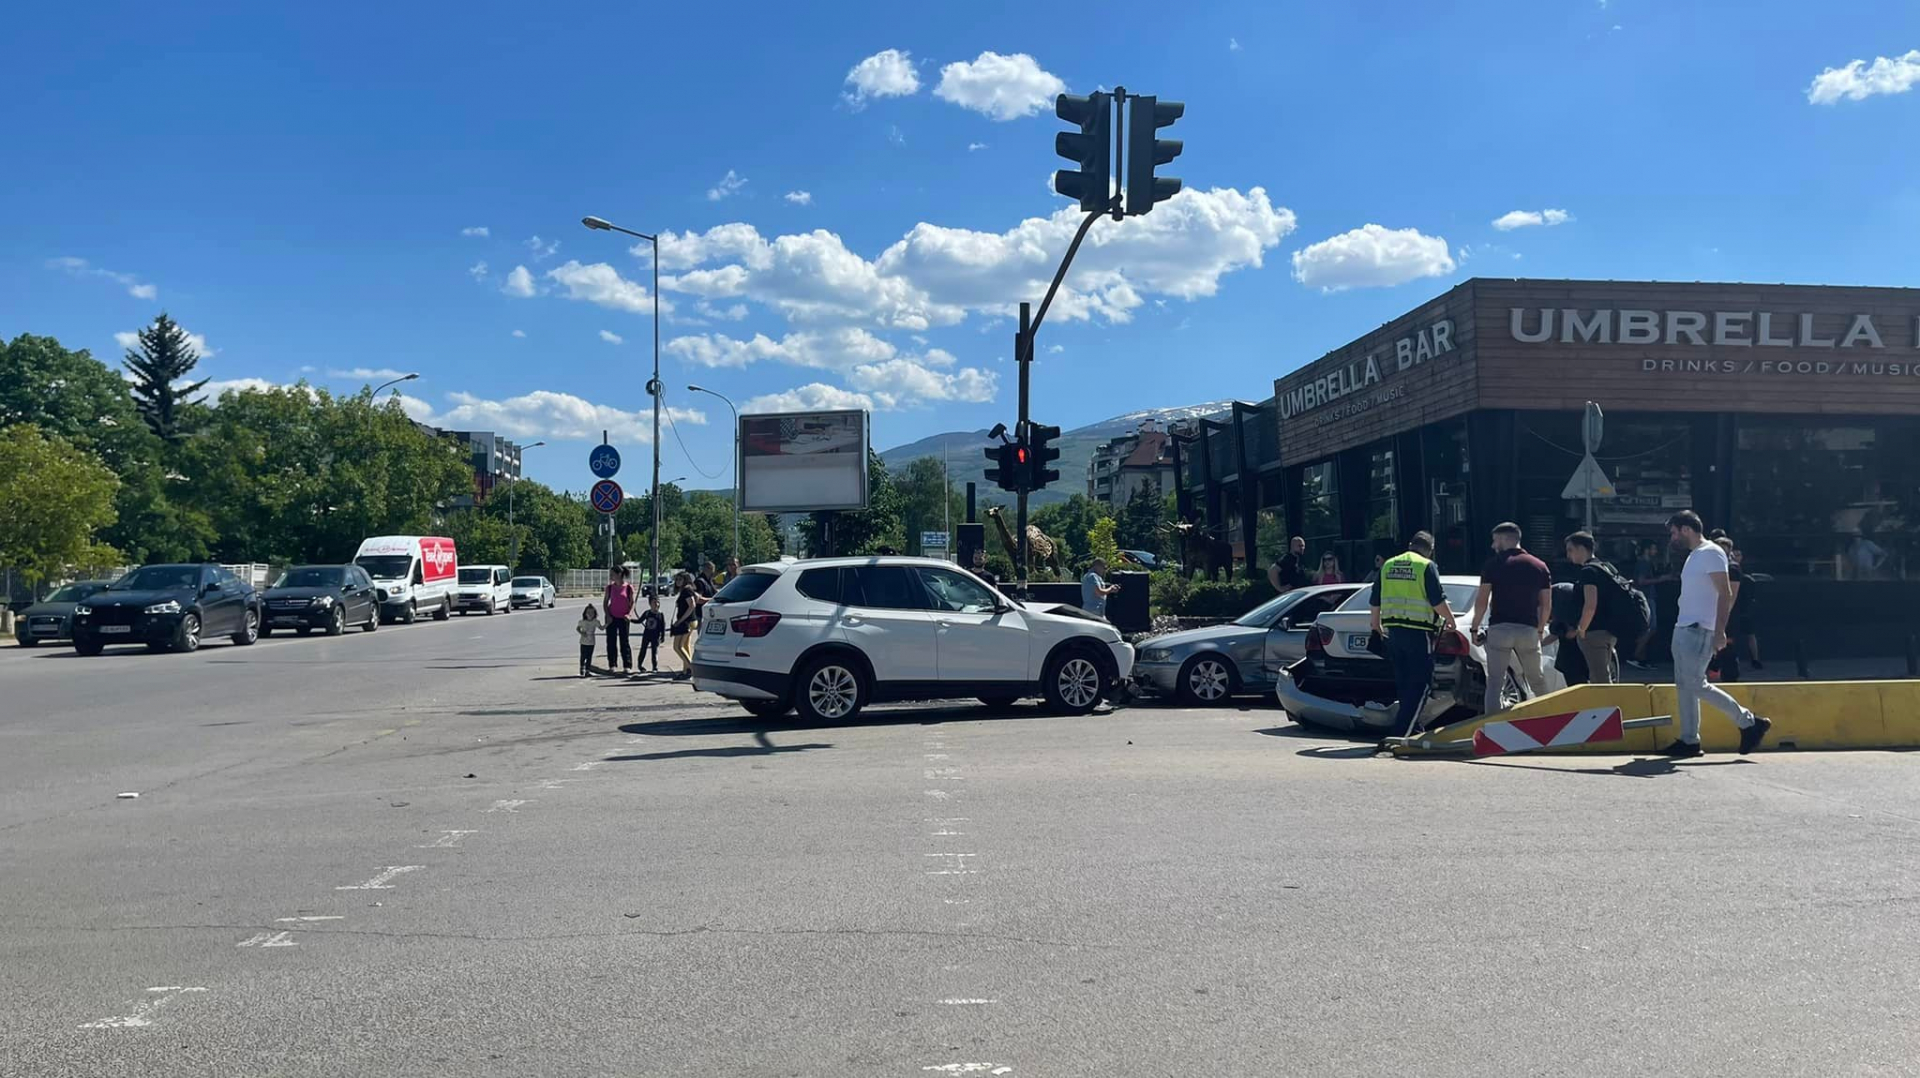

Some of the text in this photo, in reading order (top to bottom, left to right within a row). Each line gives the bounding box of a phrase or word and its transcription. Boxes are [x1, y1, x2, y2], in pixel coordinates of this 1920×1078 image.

[1509, 307, 1885, 349] UMBRELLA
[1279, 319, 1454, 420] UMBRELLA BAR
